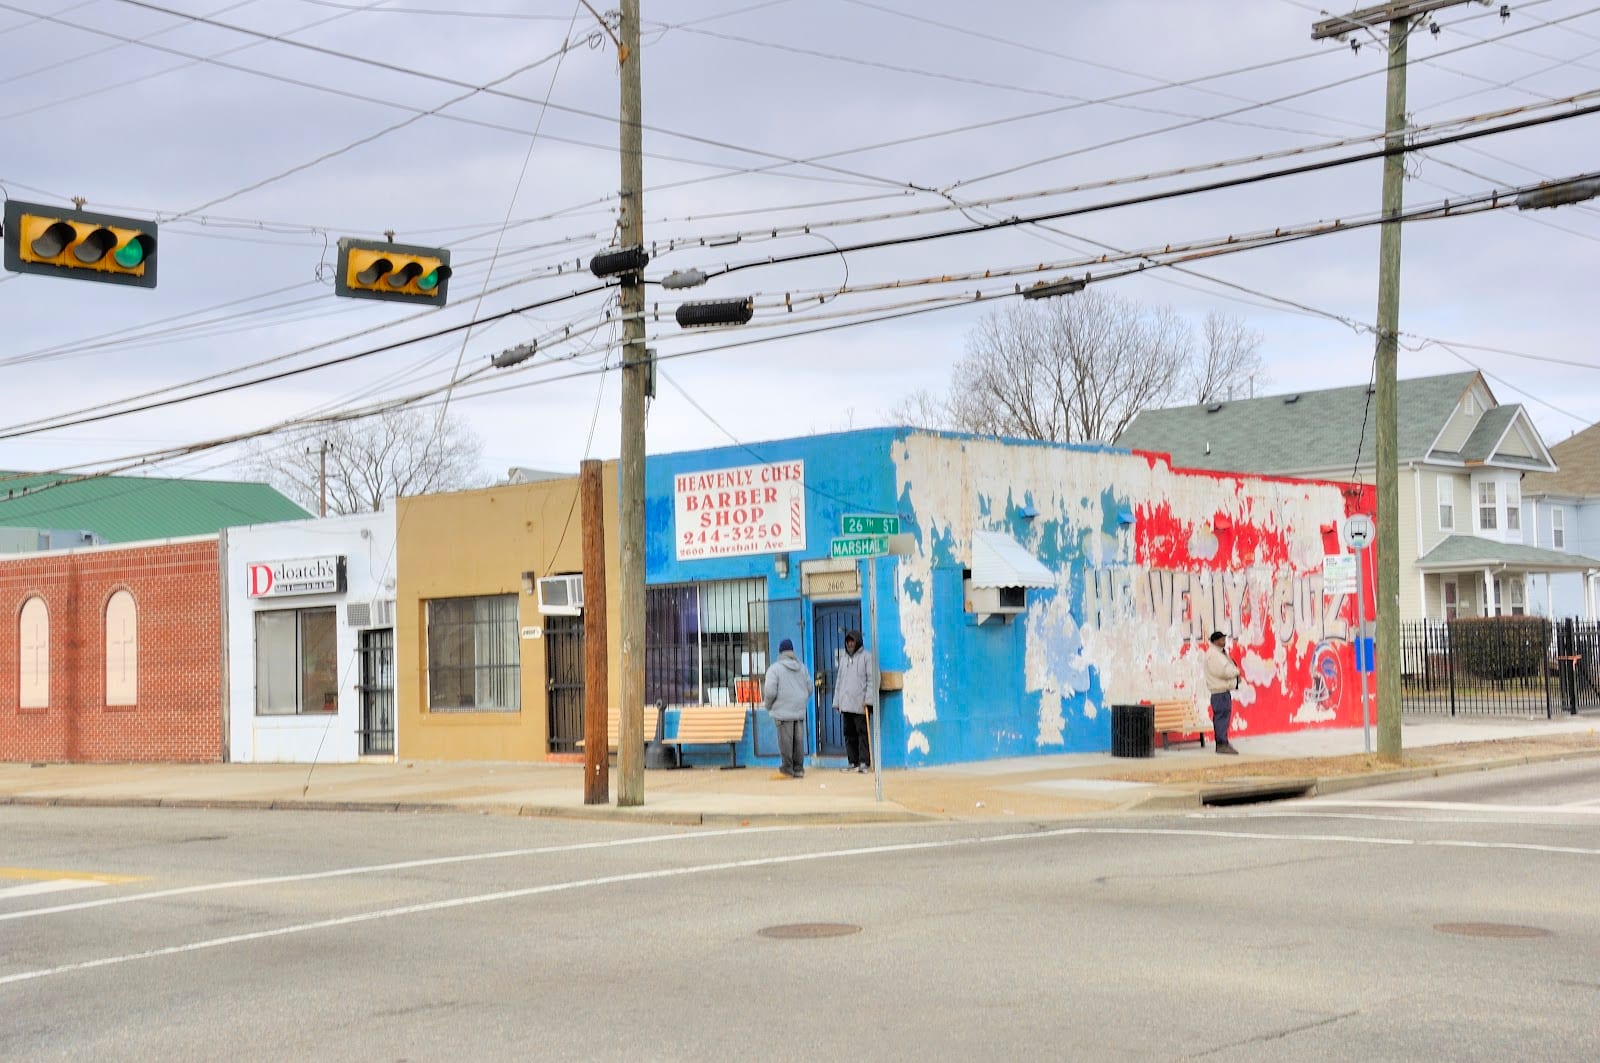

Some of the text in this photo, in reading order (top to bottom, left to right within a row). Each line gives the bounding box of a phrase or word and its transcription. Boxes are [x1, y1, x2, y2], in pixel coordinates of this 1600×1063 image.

[677, 464, 801, 492] HEAVENLY CUTS
[686, 487, 777, 512] BARBER
[700, 507, 764, 528] SHOP
[883, 519, 894, 532] ST
[683, 523, 782, 545] 244-3250
[679, 541, 783, 557] 2600 Marshall Ave
[250, 561, 334, 597] Deloatch's
